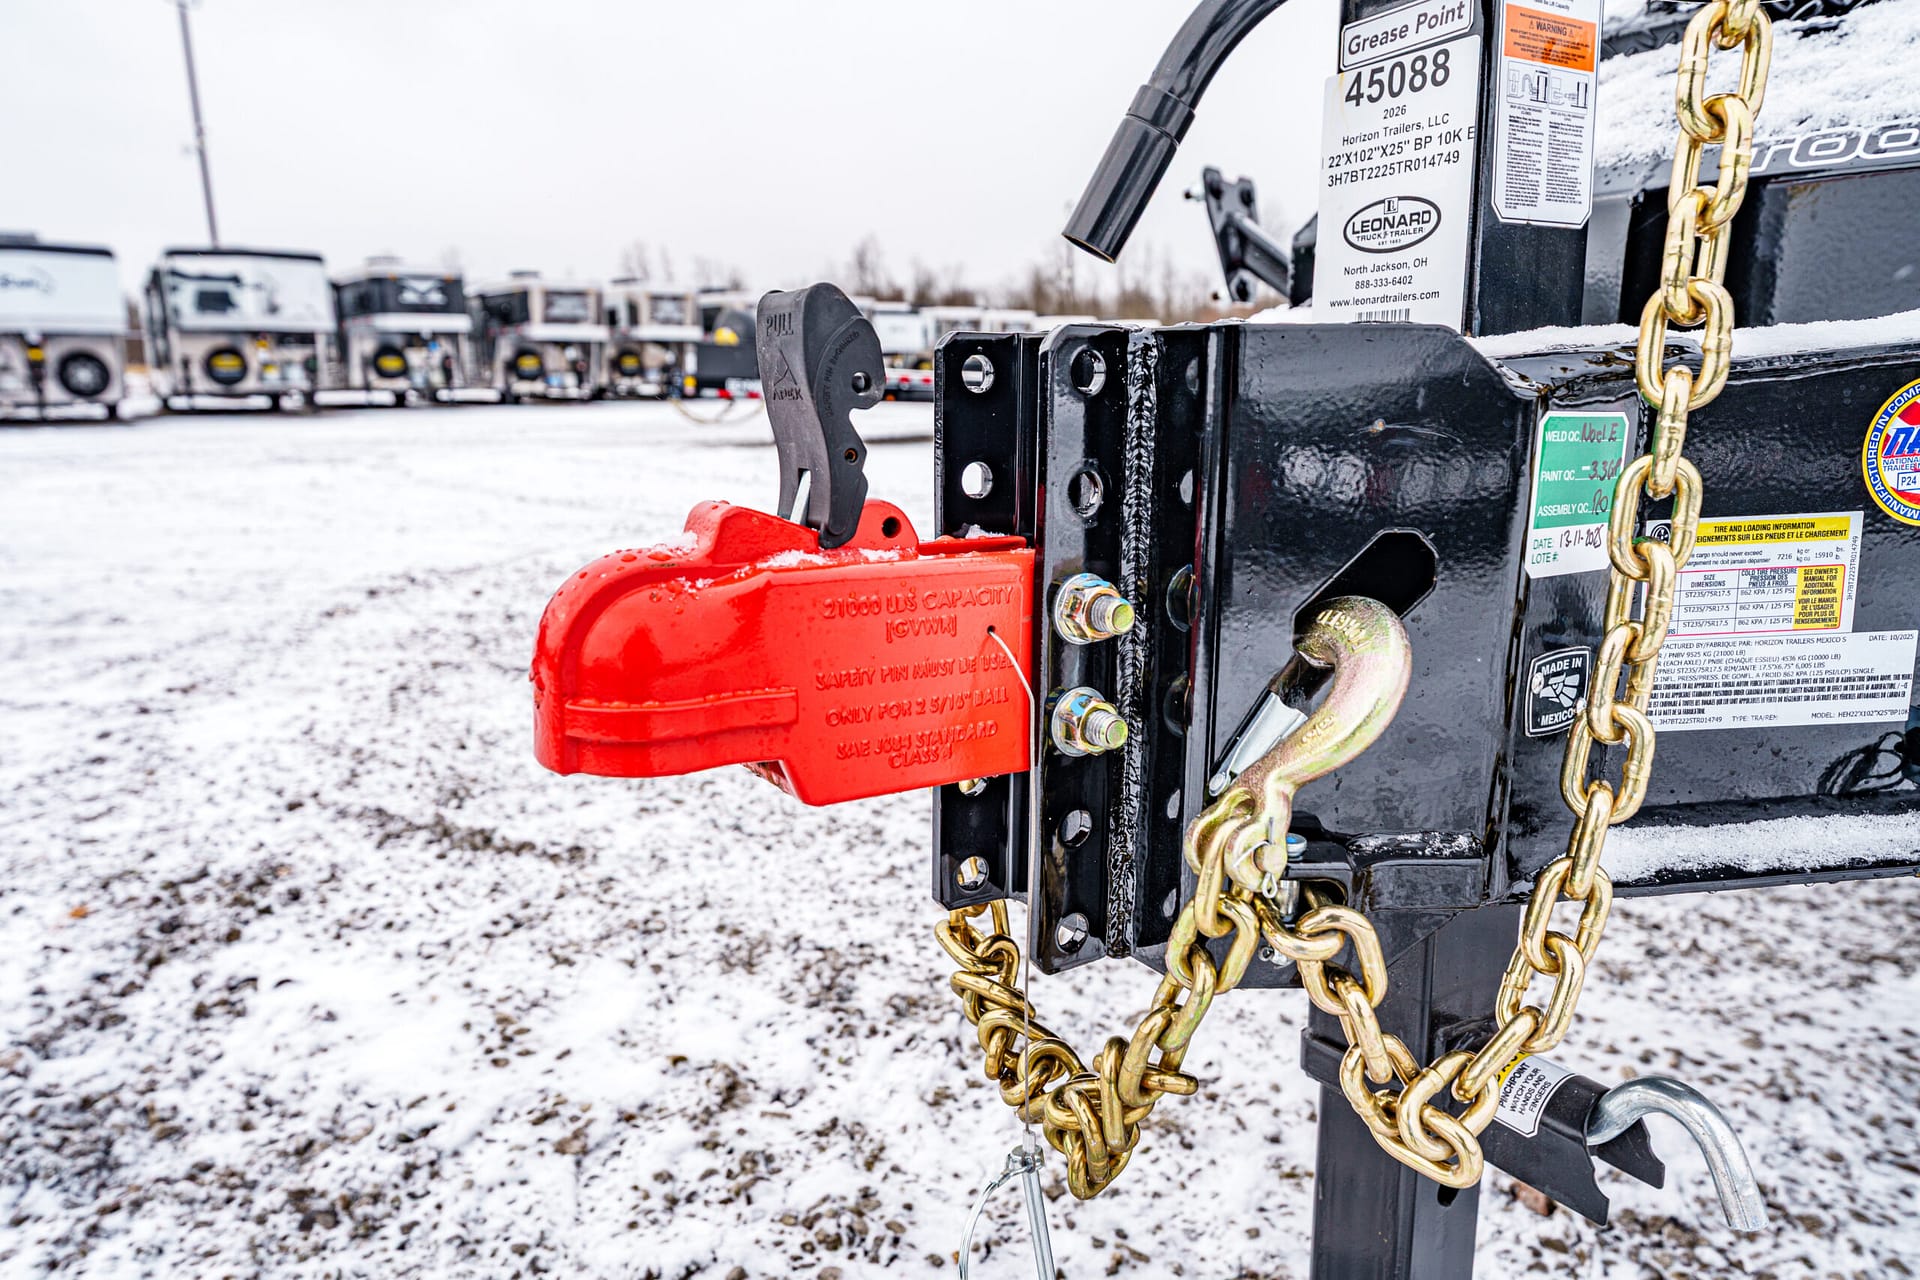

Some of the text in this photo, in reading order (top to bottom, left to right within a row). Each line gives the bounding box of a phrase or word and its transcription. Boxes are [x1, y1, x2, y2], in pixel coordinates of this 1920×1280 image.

[1348, 1, 1465, 55] Grease Point
[1536, 21, 1568, 36] WARNING
[1344, 48, 1450, 106] 45088
[1384, 105, 1406, 120] 2026
[1342, 113, 1450, 146] Horizon Trailers, LLC
[1414, 136, 1432, 151] BP
[1437, 128, 1462, 146] 10K
[1328, 150, 1460, 187] 3H7BT2225TR014749
[1352, 210, 1432, 235] LEONARD
[1356, 232, 1382, 242] TRUCK
[1390, 226, 1424, 237] TRAILER
[1344, 257, 1428, 276] North Jackson, OH
[1355, 275, 1413, 290] 888-333-6402
[1330, 290, 1440, 308] www.leonardtrailers.com
[766, 312, 794, 336] PULL
[1876, 414, 1890, 429] IN
[1546, 430, 1568, 442] WELD
[1540, 470, 1562, 482] PAINT
[1868, 432, 1920, 519] MANUFACTURED
[1901, 476, 1916, 486] P24
[1538, 504, 1576, 517] ASSEMBLY
[1696, 534, 1736, 543] EIGNEMENTS
[1737, 534, 1750, 542] SUR
[1764, 532, 1786, 540] PNEUS
[1804, 530, 1847, 538] CHARGEMENT
[1744, 524, 1771, 532] LOADING
[1772, 522, 1816, 530] INFORMATION
[1532, 552, 1550, 564] LOTE
[1690, 580, 1726, 588] DIMENSIONS
[1754, 588, 1766, 596] KPA
[822, 586, 1014, 619] 21000 LBS CAPACITY
[1541, 657, 1582, 676] MADE IN
[1808, 654, 1830, 662] (10000
[816, 667, 876, 691] SAFETY
[880, 664, 909, 683] PIN
[912, 657, 955, 680] MUST
[958, 656, 977, 674] BE
[1783, 670, 1794, 678] 862
[826, 705, 874, 727] ONLY
[878, 700, 912, 720] FOR
[916, 698, 926, 716] 2
[974, 686, 1009, 706] BALL
[1540, 710, 1574, 726] MEXICO
[836, 740, 870, 760] SAE
[916, 720, 998, 749] STANDARD
[888, 746, 940, 769] CLASS
[1499, 1062, 1530, 1108] PINCHPOINT
[1510, 1084, 1527, 1112] WATCH
[1522, 1068, 1542, 1084] YOUR
[1518, 1074, 1546, 1115] HANDS AND
[1528, 1081, 1552, 1112] FINGERS
